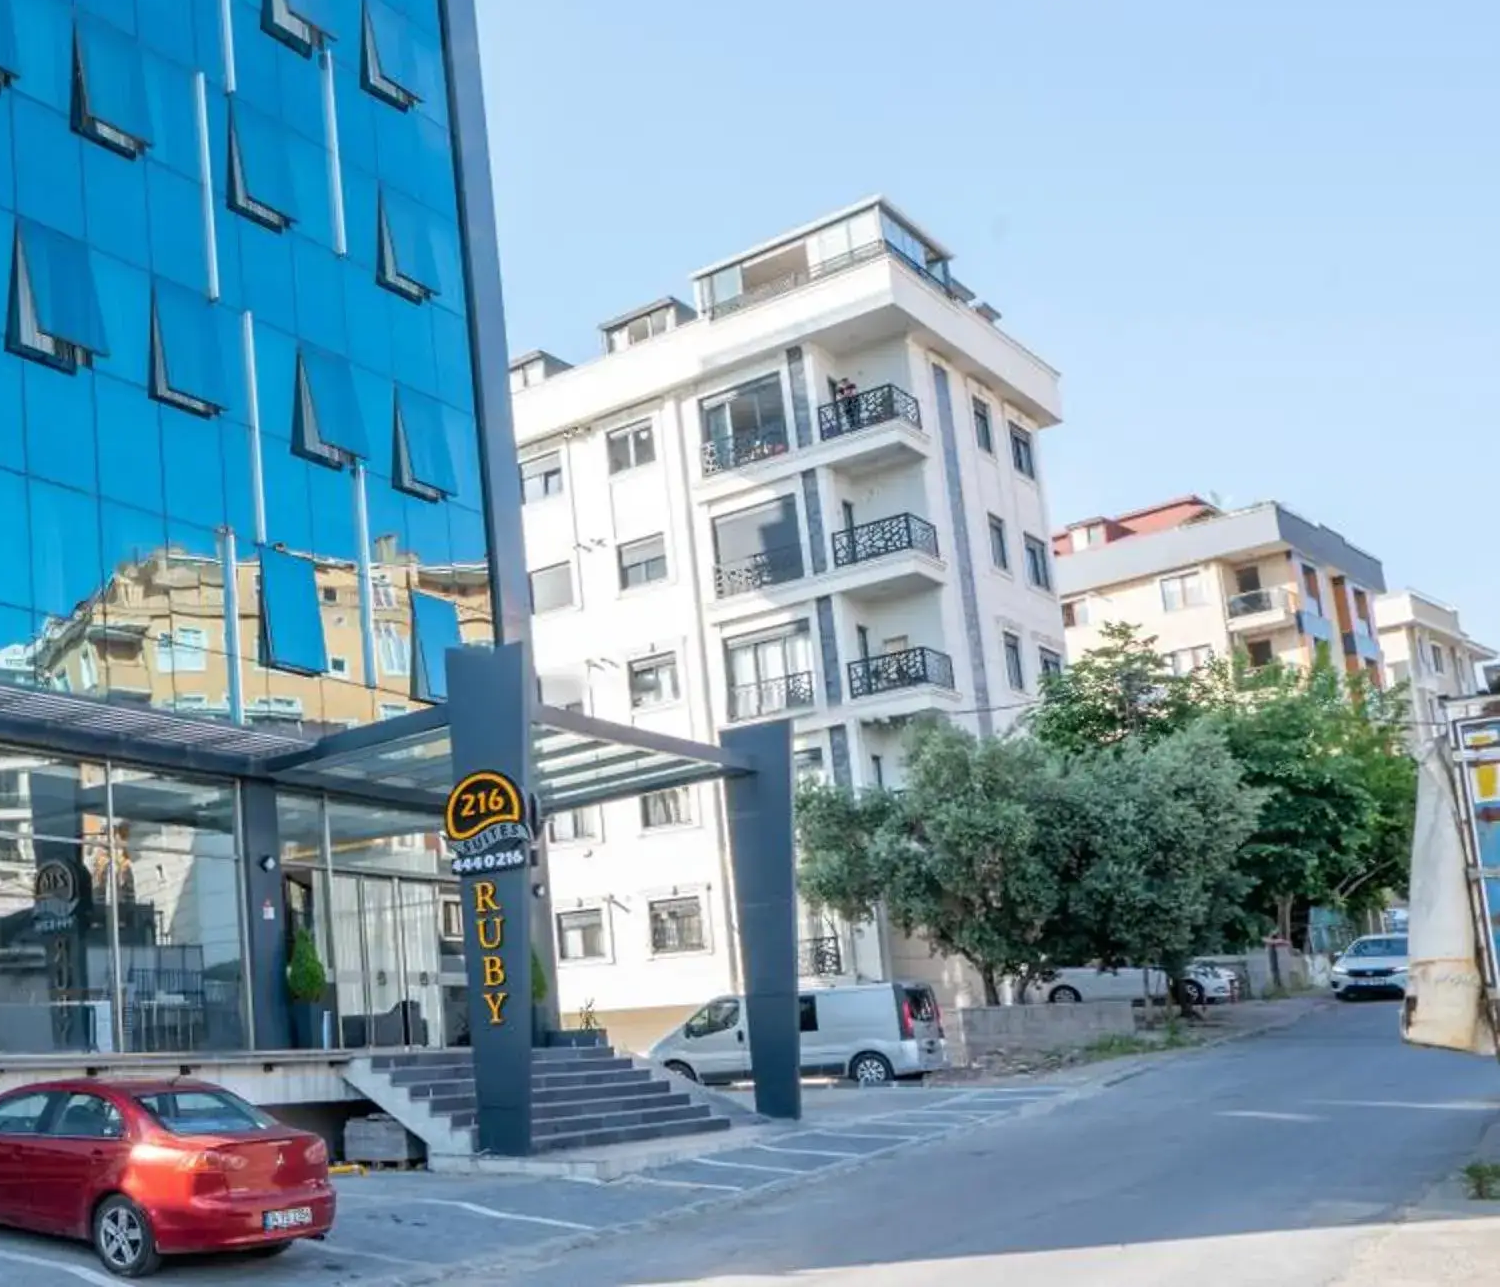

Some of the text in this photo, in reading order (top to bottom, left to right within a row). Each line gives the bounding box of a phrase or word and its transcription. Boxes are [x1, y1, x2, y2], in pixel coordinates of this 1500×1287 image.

[461, 788, 505, 818] 216
[462, 823, 520, 853] SUITES
[473, 881, 508, 1026] RUBY
